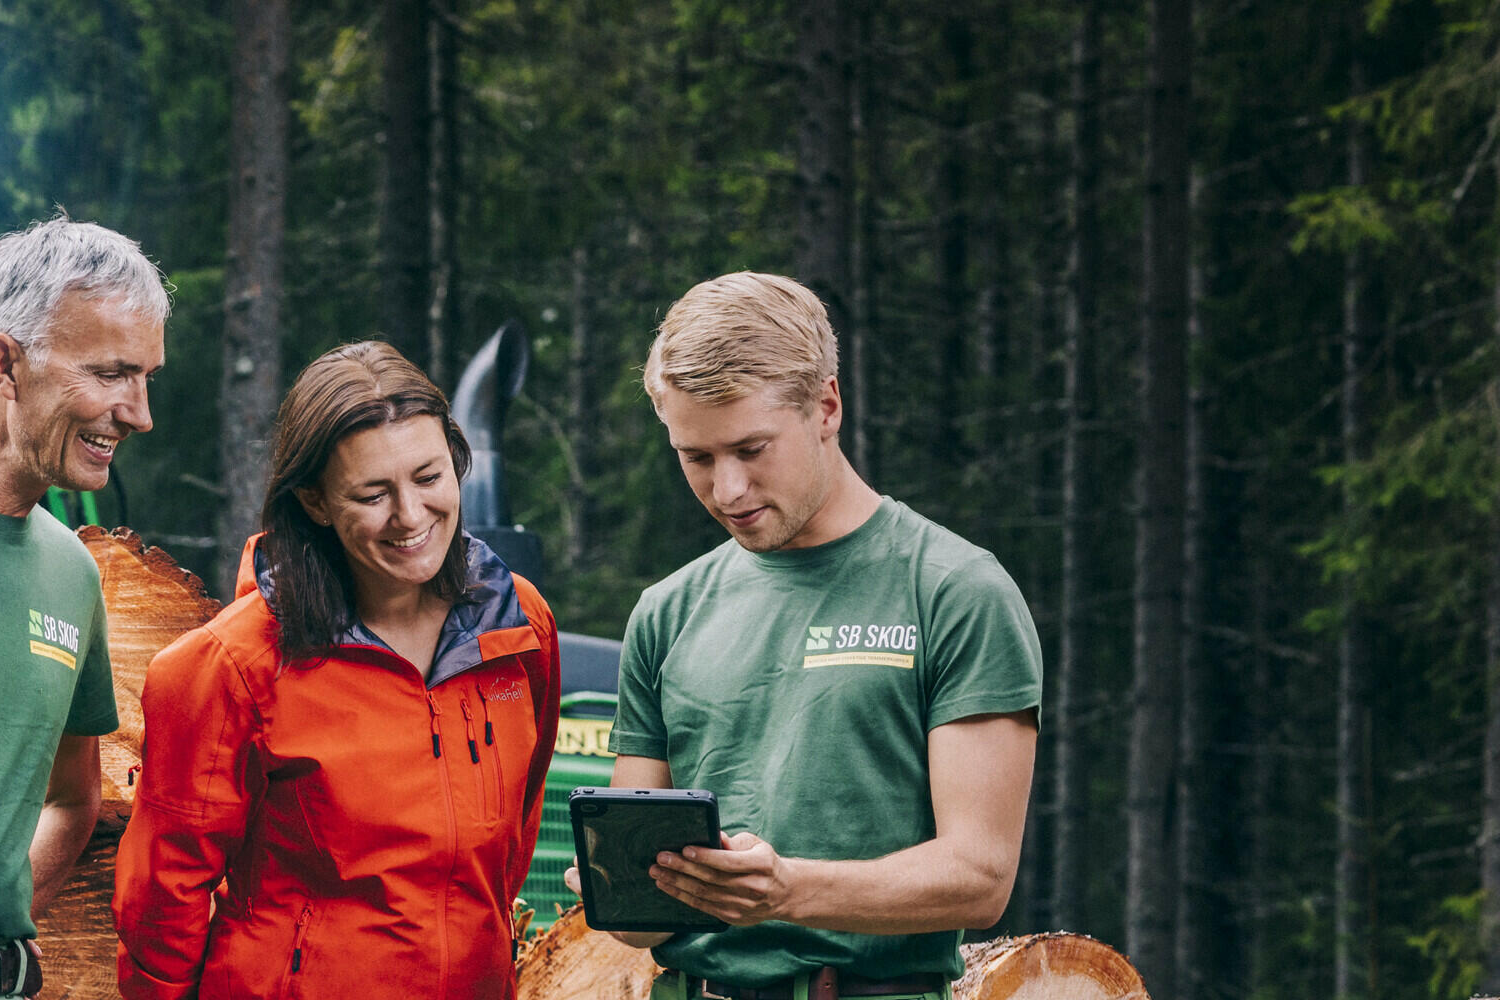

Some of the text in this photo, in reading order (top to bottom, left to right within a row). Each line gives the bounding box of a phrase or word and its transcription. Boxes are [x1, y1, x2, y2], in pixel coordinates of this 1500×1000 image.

[43, 614, 79, 654] SB SKOG
[836, 624, 917, 651] SB SKOG
